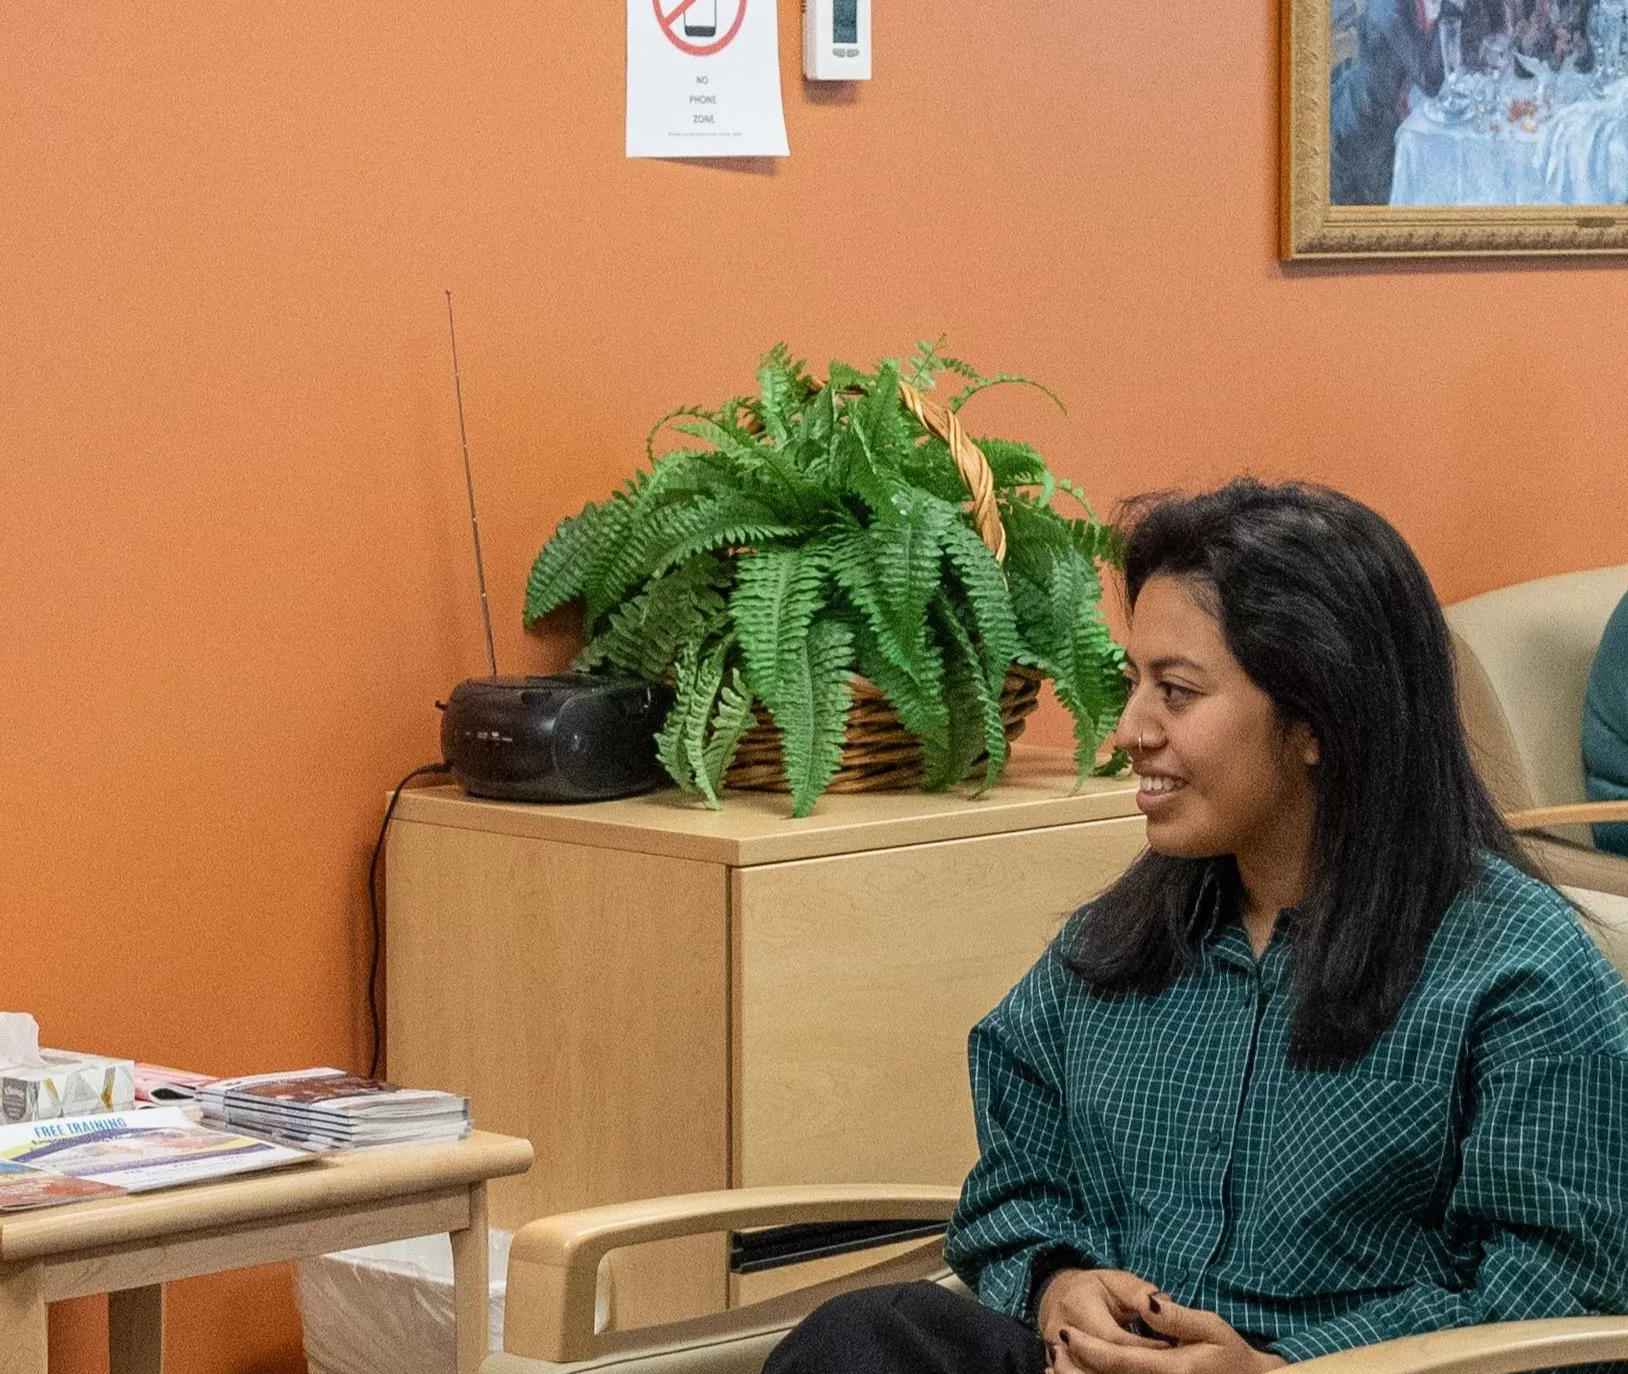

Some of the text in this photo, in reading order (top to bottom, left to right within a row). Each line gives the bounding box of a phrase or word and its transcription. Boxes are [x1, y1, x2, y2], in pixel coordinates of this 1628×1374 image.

[695, 75, 709, 85] NO
[689, 94, 717, 104] PHONE
[692, 114, 715, 124] ZONE
[34, 1117, 127, 1138] FREE TRAINING
